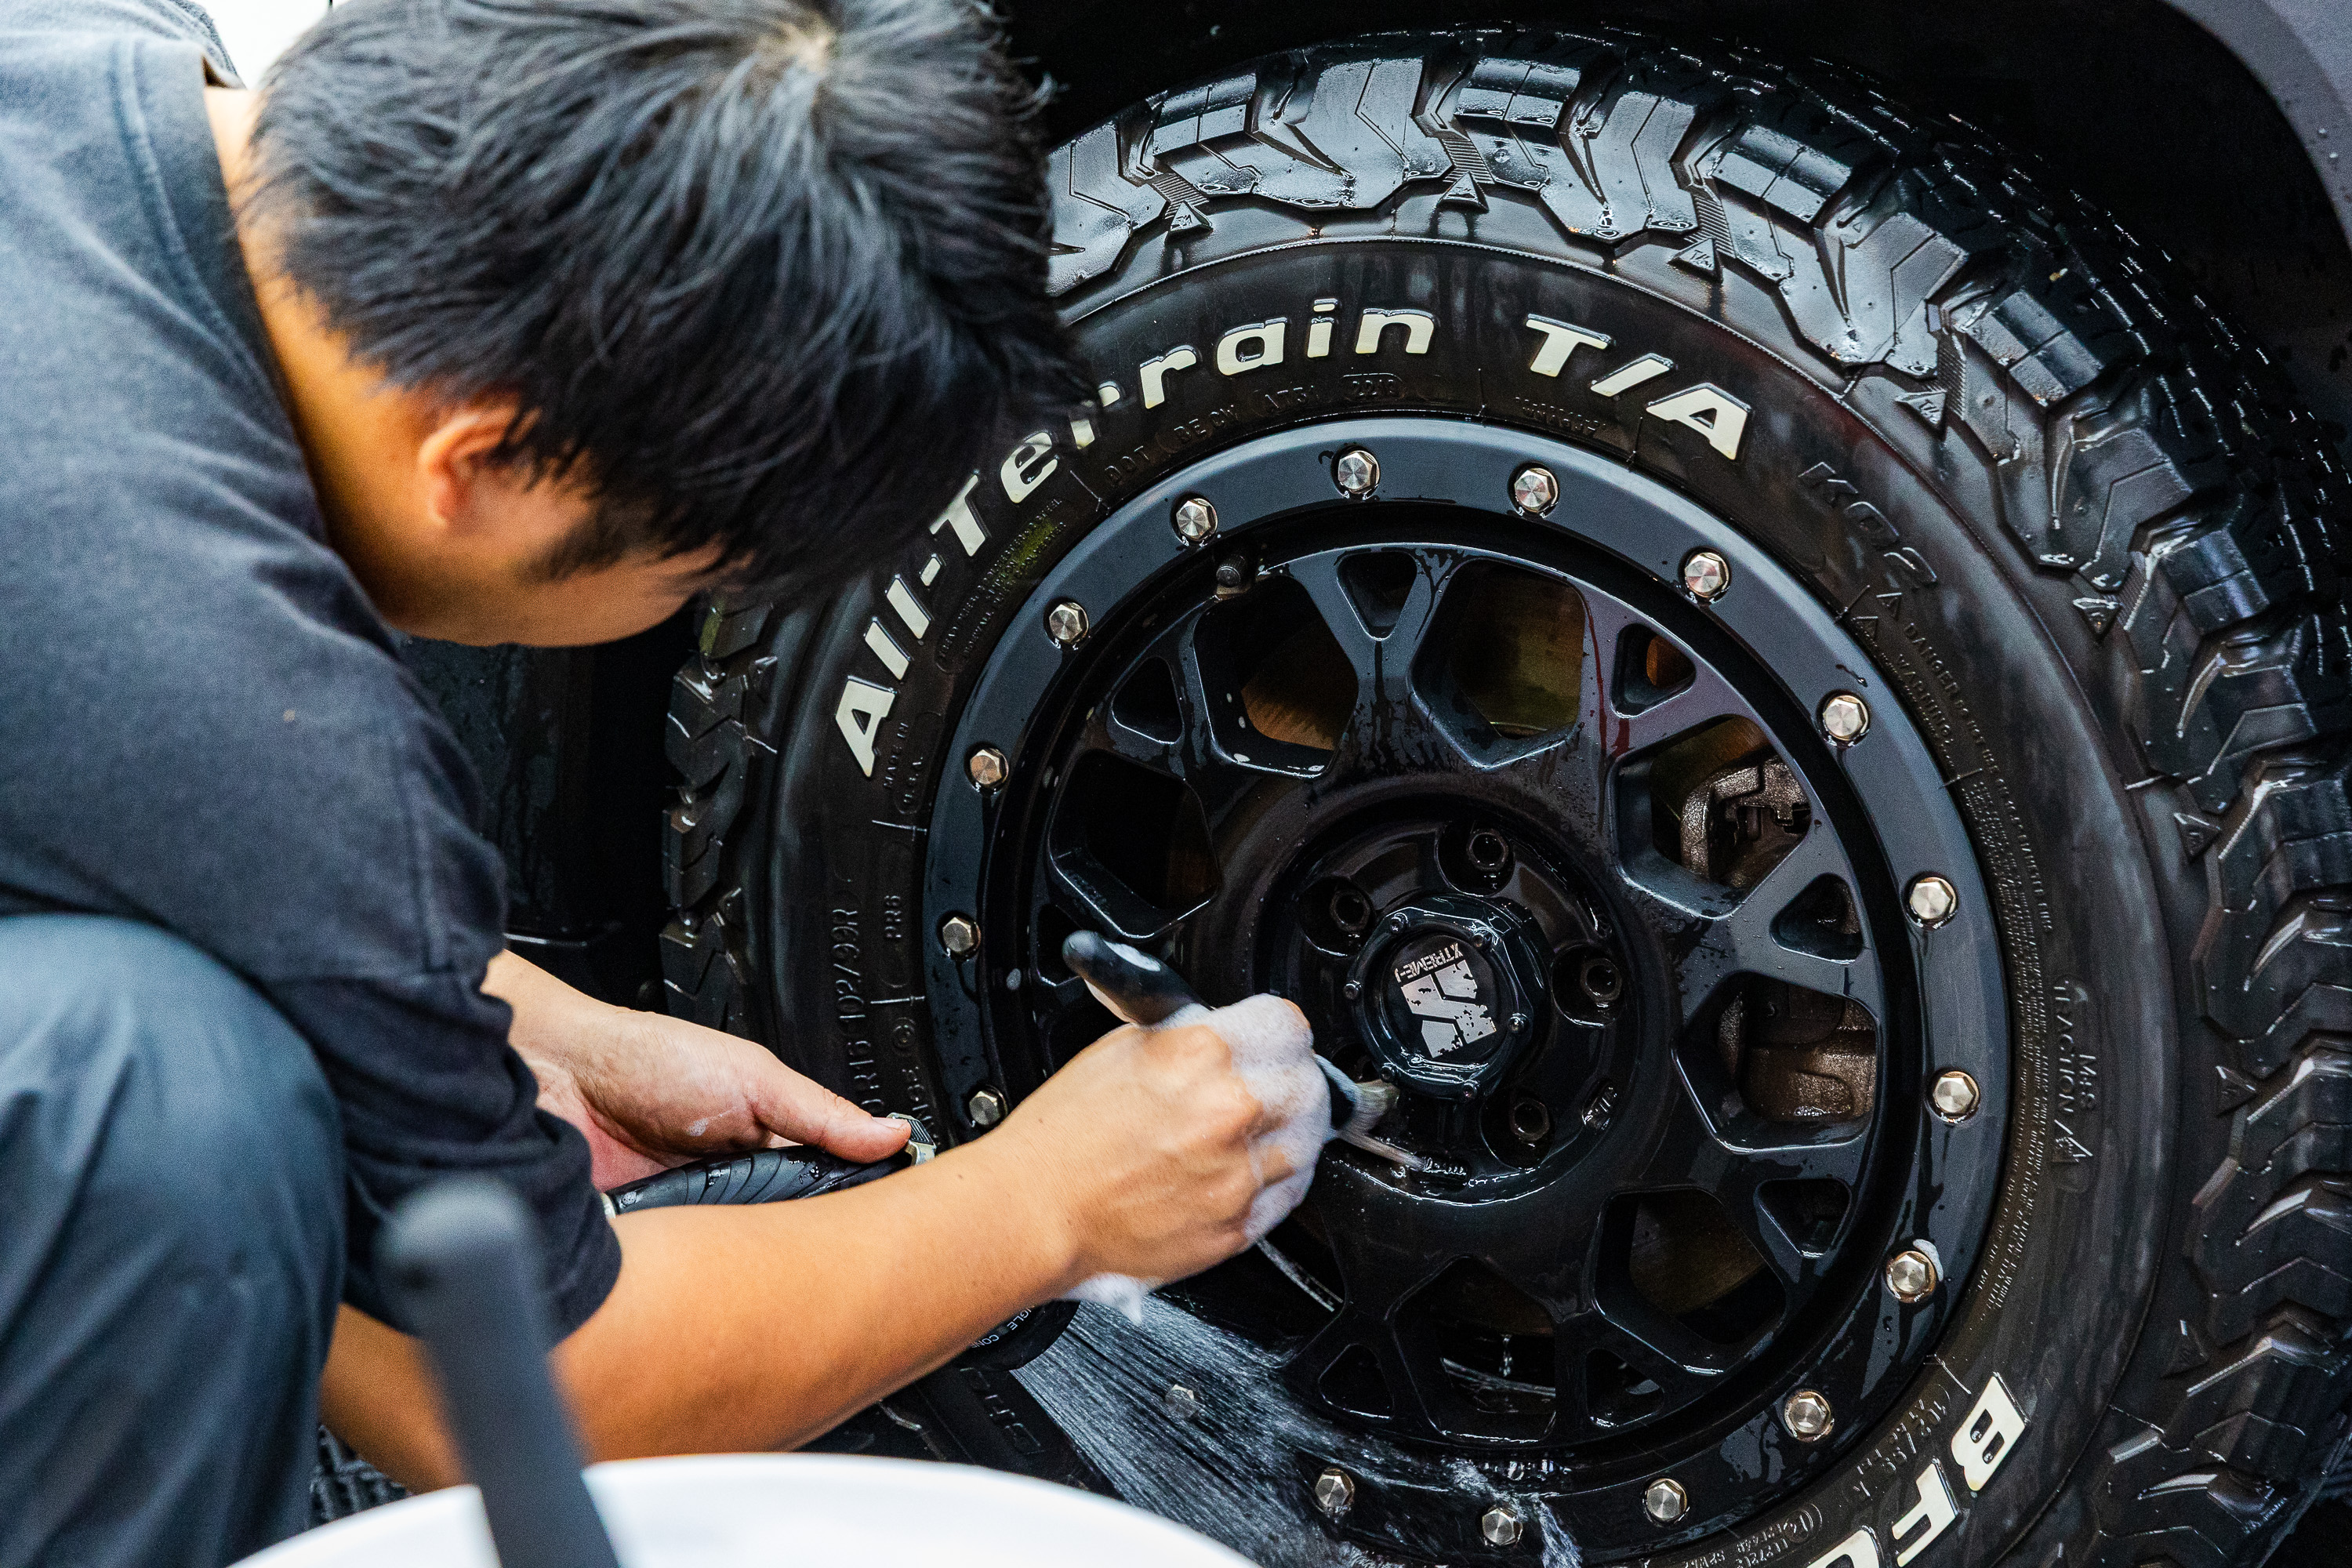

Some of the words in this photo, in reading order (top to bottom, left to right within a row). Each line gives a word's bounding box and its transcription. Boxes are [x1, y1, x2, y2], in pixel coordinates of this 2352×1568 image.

[1105, 445, 1150, 487] DOT
[835, 299, 1437, 779] All-Terrain
[1526, 313, 1753, 461] T/A
[1797, 461, 1939, 592] KO2
[1904, 622, 1960, 695] DANGER
[1395, 942, 1464, 983] XTREME-J
[2053, 980, 2076, 1114] TRACTION
[2079, 1054, 2097, 1111] M+S
